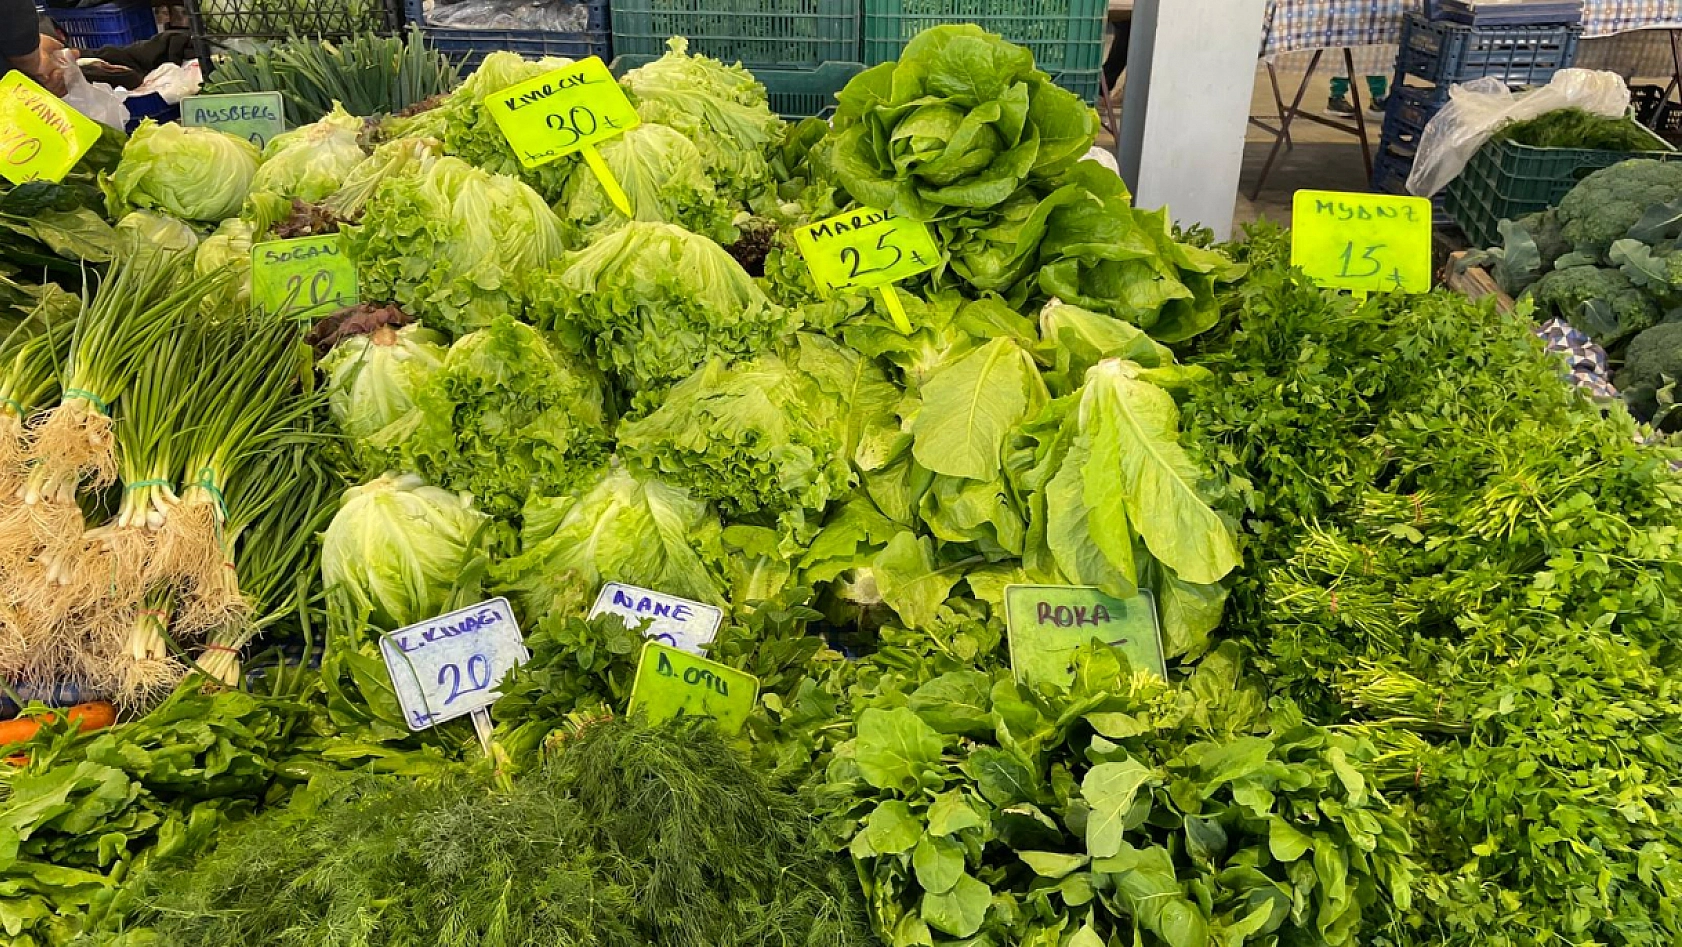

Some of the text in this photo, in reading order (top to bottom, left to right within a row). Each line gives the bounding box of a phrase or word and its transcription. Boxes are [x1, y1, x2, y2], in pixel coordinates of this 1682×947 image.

[194, 105, 277, 123] AYSBERG
[546, 105, 598, 148] 30
[809, 209, 899, 242] MARUL
[840, 227, 902, 279] 25
[1334, 240, 1388, 278] 15
[286, 268, 334, 312] 20
[612, 590, 696, 622] NANE
[1036, 601, 1112, 628] ROKA
[437, 653, 493, 706] 20
